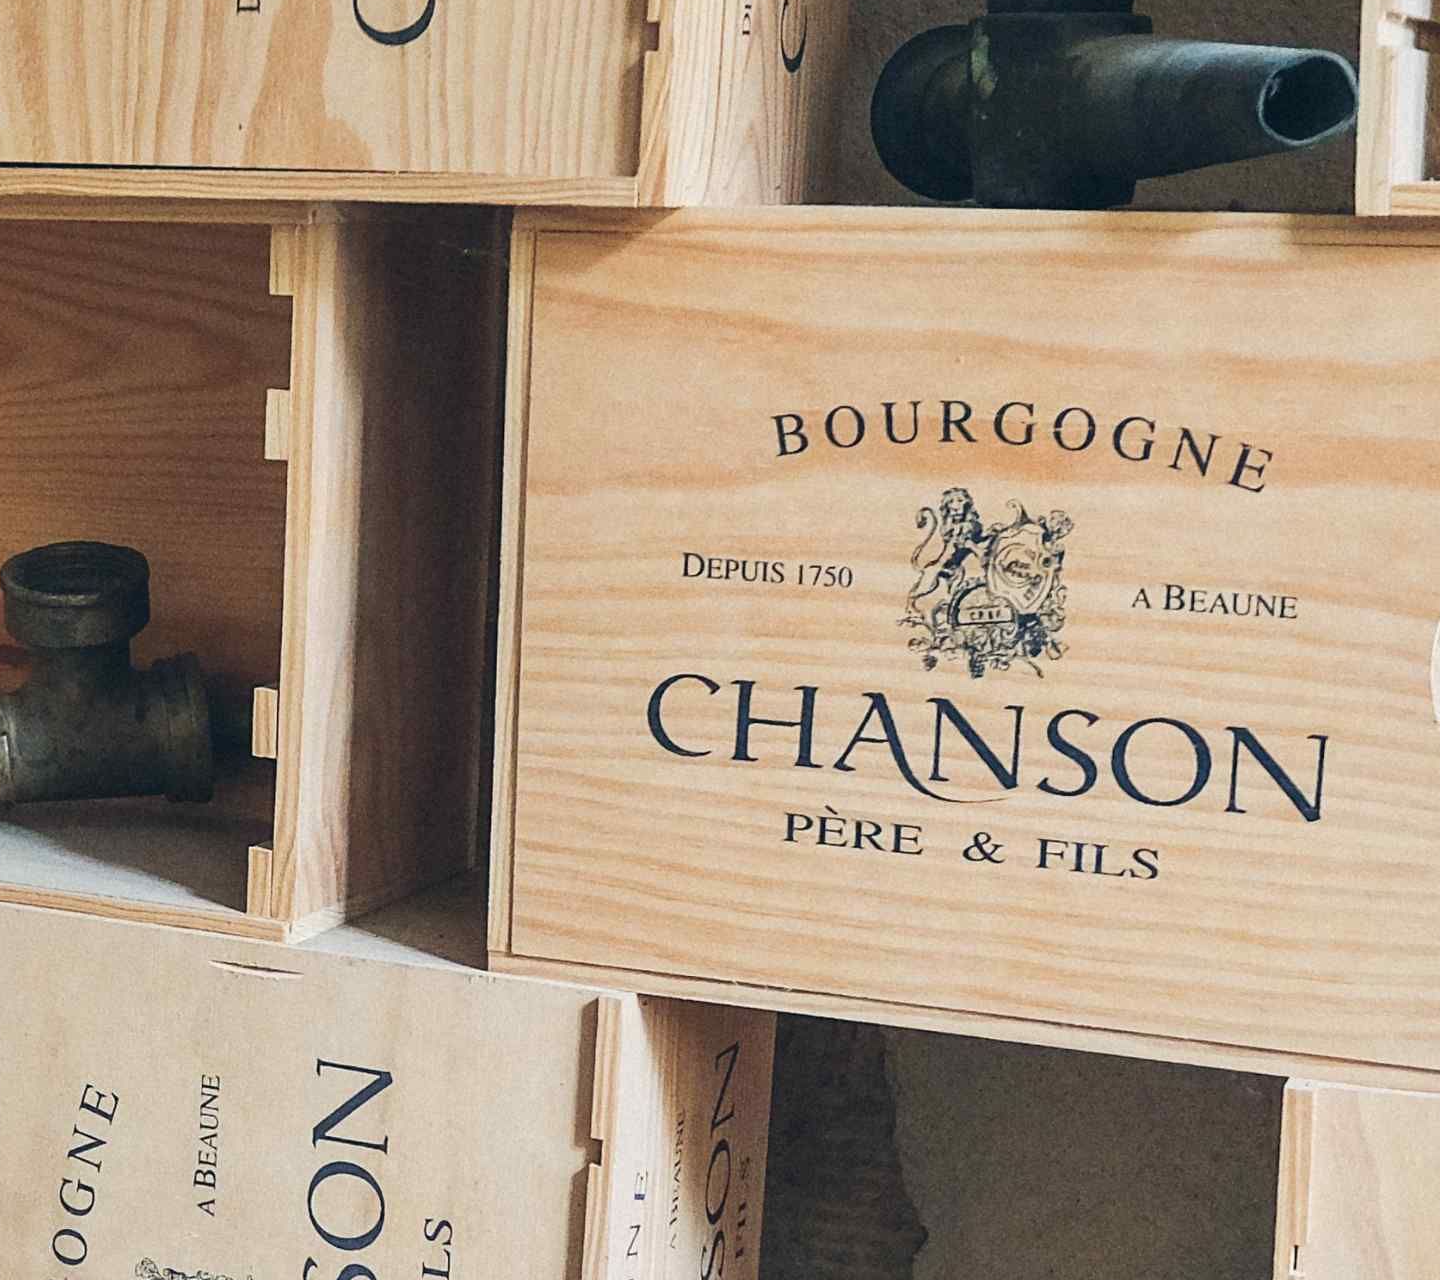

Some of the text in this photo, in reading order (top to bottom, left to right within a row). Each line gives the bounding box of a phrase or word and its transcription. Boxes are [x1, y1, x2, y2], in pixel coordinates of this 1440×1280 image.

[771, 398, 1275, 495] BOURGOGNE
[681, 549, 854, 589] DEPUIS 1750
[1130, 581, 1299, 621] A BEAUNE
[646, 670, 1330, 826] CHANSON
[783, 805, 1162, 881] PÈRE & FILS
[192, 1073, 222, 1218] A BEAUNE
